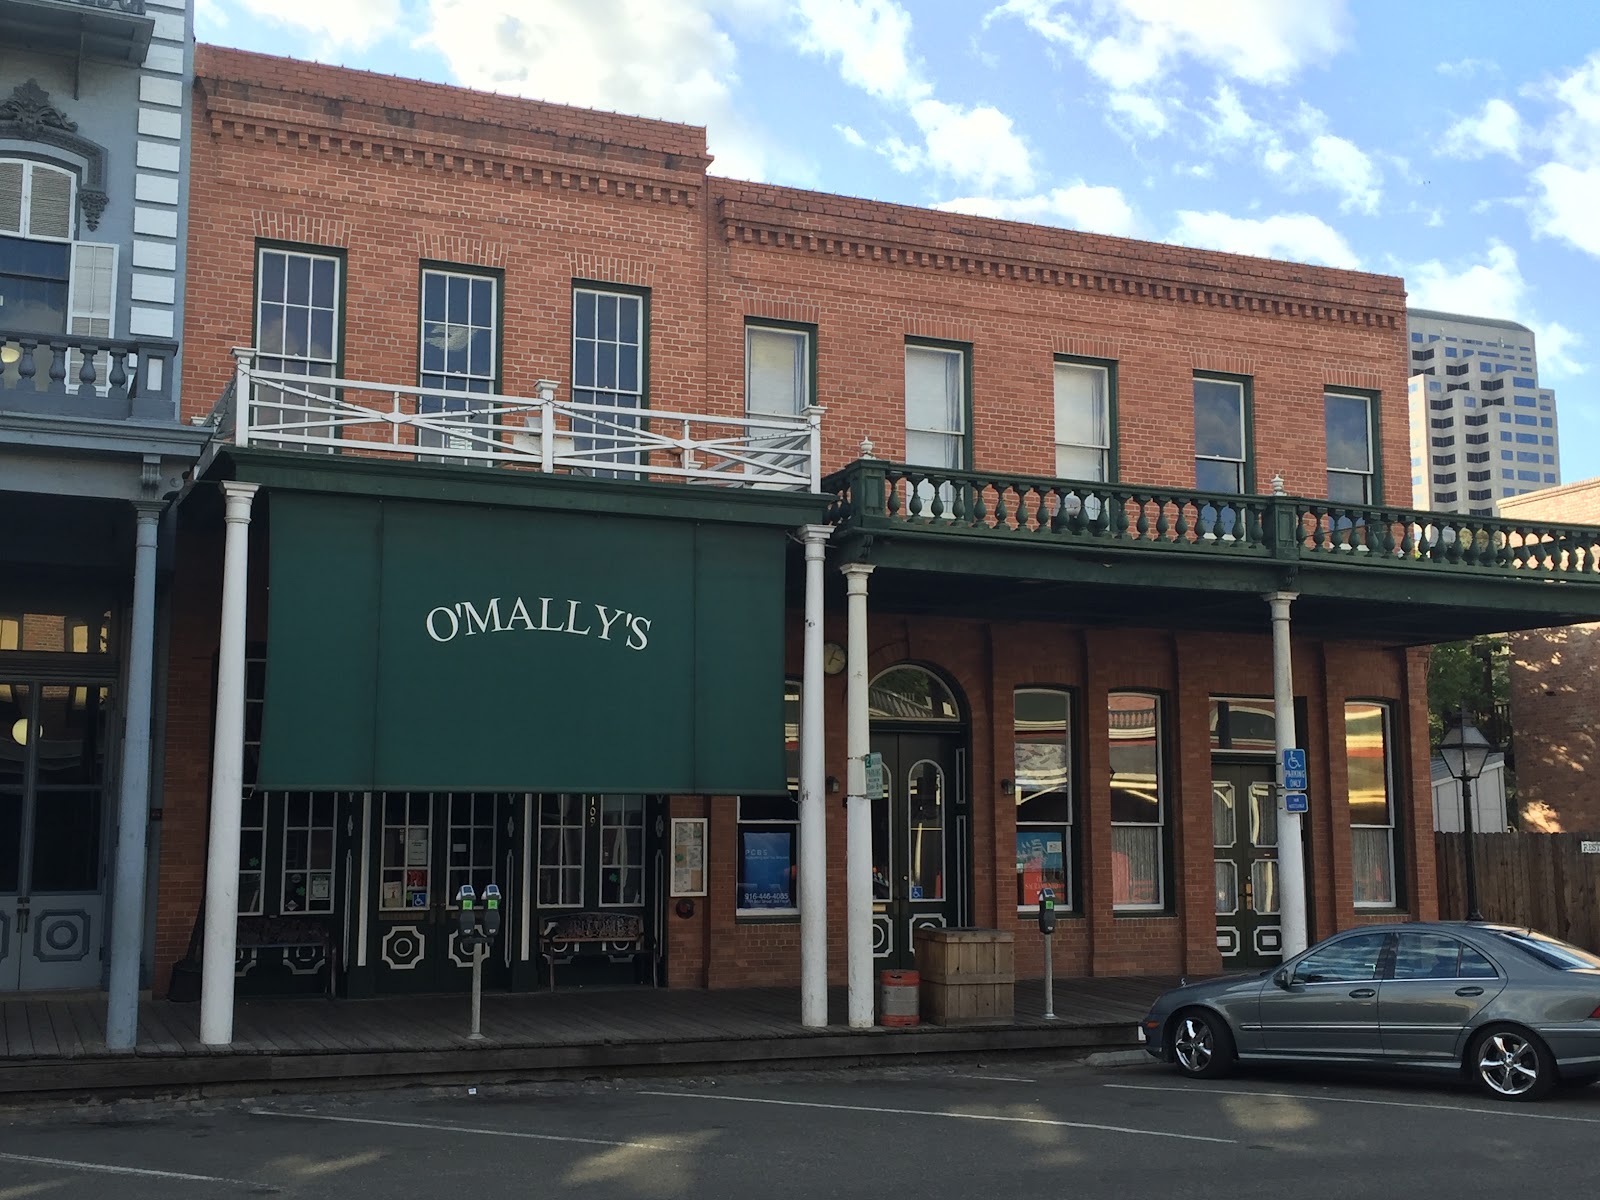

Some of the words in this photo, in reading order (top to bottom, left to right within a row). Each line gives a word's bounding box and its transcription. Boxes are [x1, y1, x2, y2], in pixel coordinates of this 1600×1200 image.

[426, 597, 652, 651] O'MALLY'S
[1286, 770, 1305, 778] PARKING
[1290, 779, 1302, 788] ONLY
